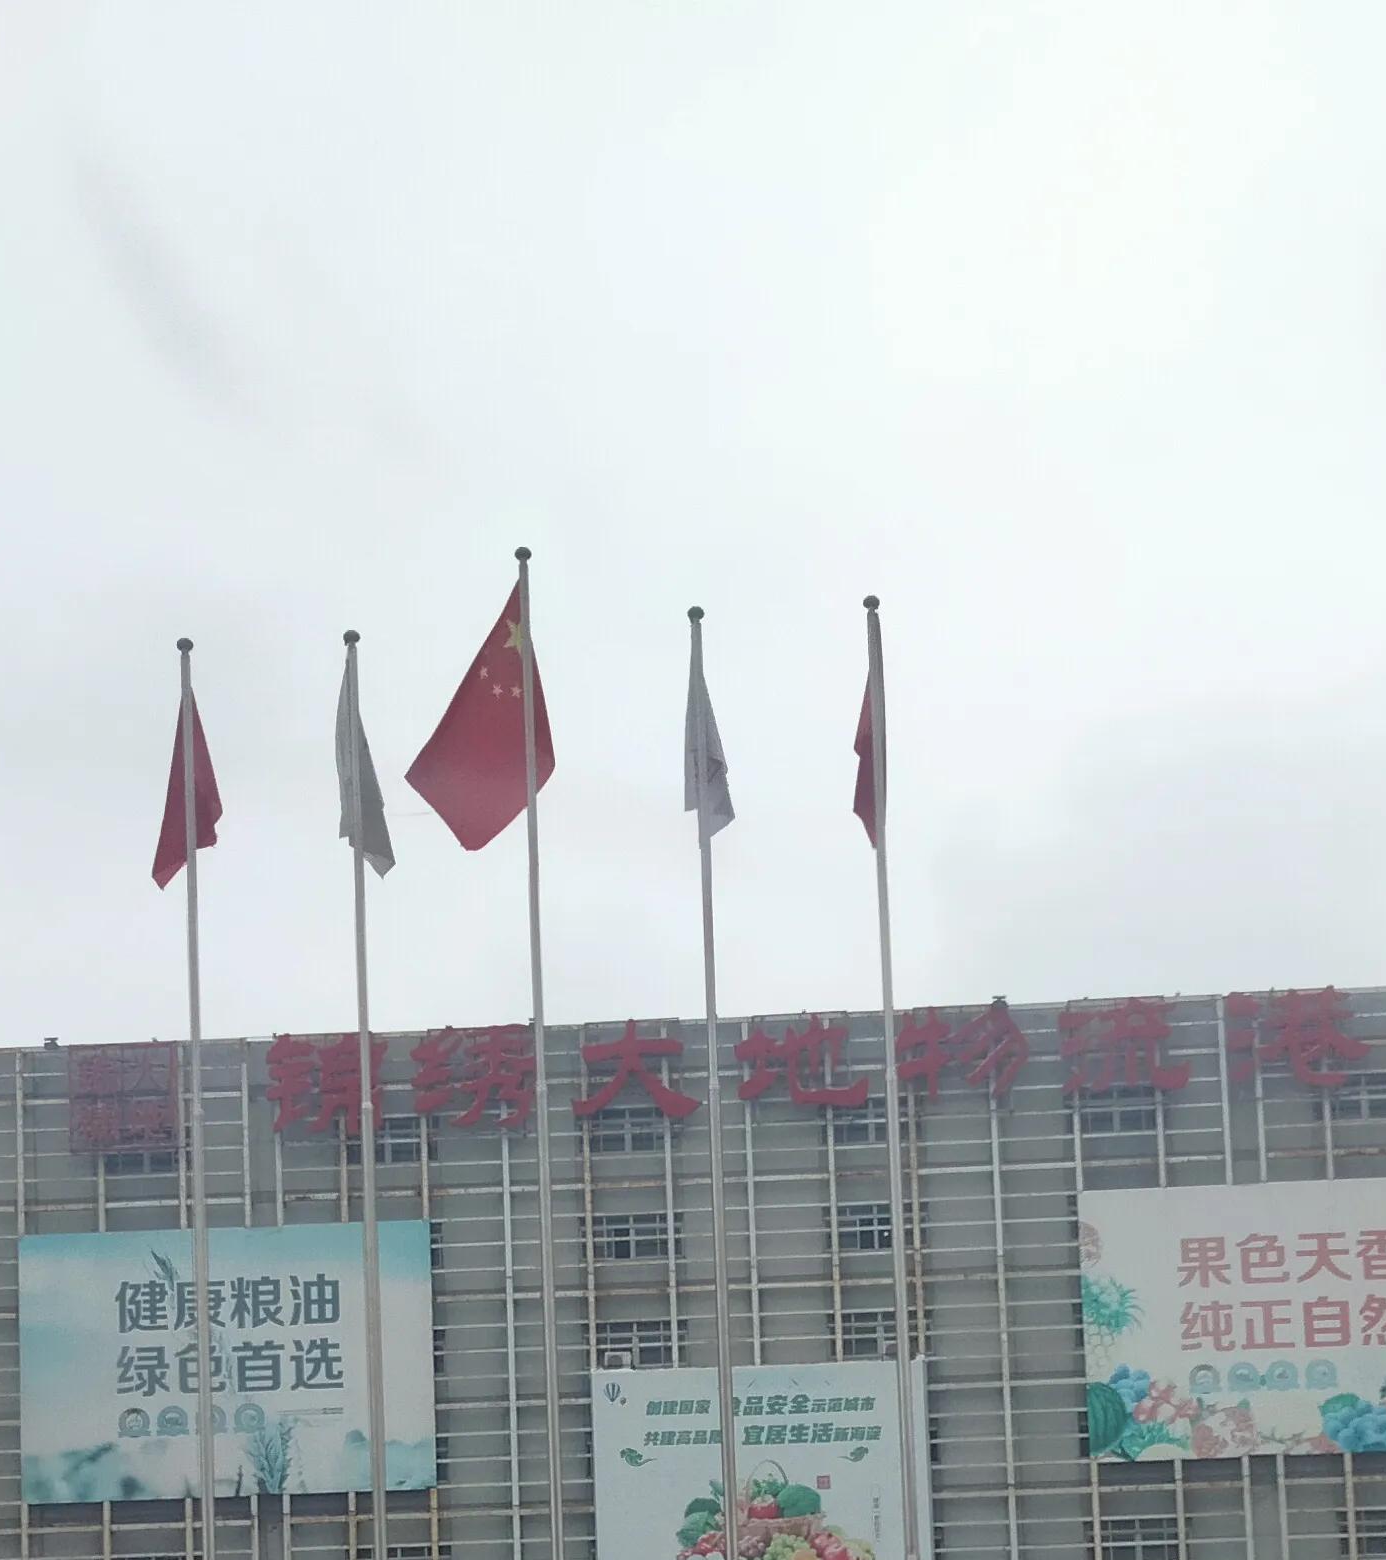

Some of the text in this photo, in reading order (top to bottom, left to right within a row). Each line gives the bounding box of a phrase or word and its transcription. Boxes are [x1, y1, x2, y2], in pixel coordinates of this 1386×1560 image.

[266, 985, 1371, 1133] 锦绣大地物流港
[115, 1273, 341, 1333] 健康粮油
[116, 1338, 345, 1396] 绿色首选
